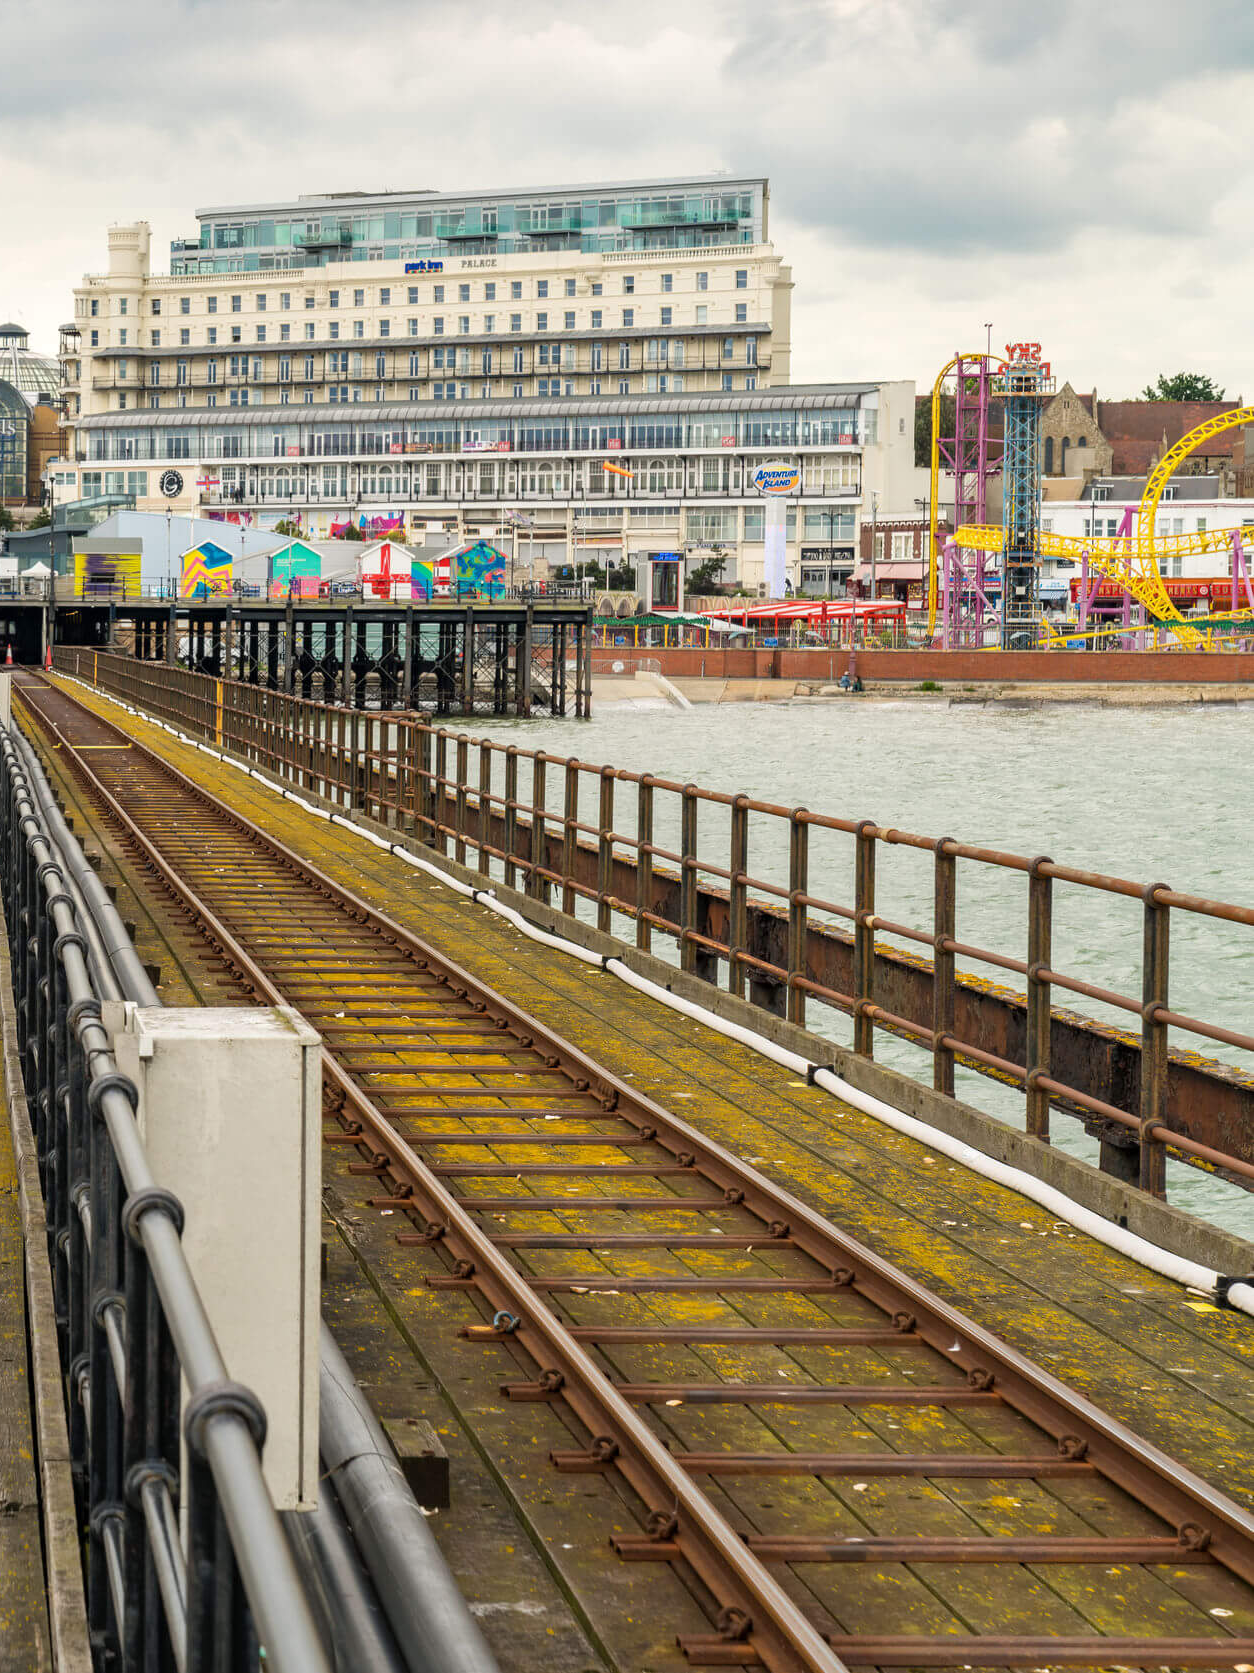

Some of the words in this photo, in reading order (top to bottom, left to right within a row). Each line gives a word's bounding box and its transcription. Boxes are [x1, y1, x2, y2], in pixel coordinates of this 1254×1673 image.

[405, 259, 426, 273] park
[427, 259, 443, 269] inn
[461, 259, 497, 268] PALACE
